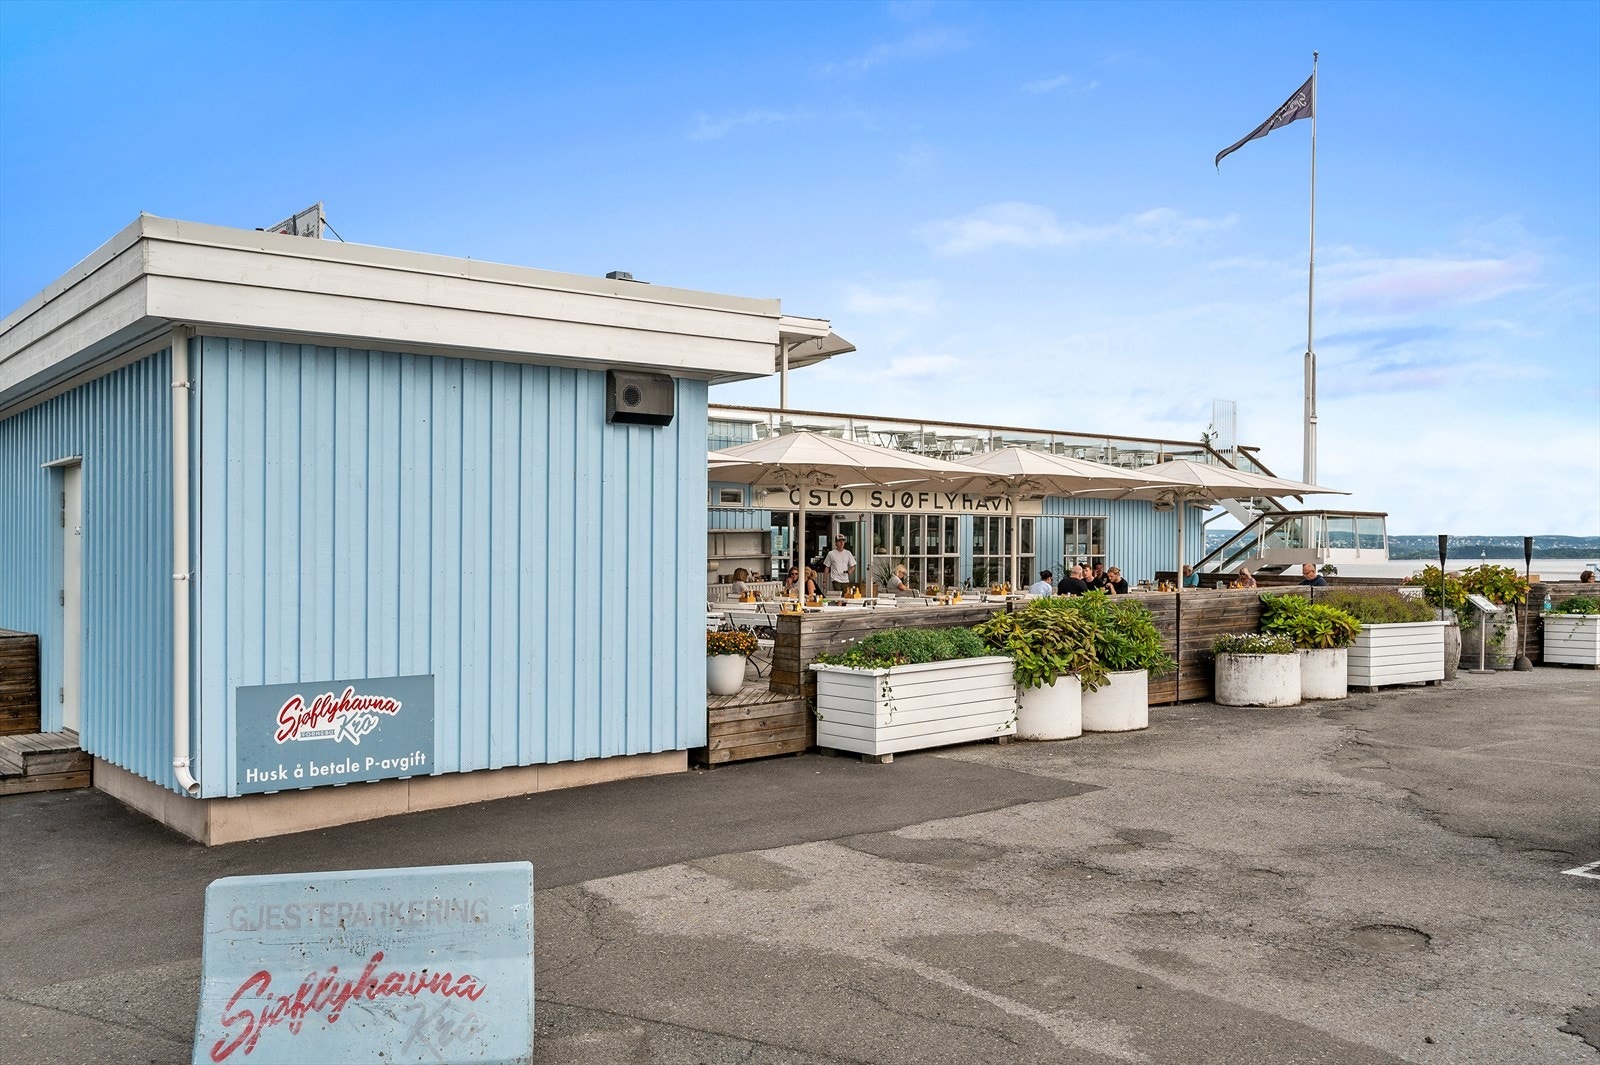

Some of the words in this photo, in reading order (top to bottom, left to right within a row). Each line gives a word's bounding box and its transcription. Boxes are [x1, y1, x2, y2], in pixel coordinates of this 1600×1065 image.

[789, 489, 854, 507] OSLO
[277, 688, 400, 742] Sjøflyhavna
[336, 712, 377, 744] Kro
[246, 764, 288, 783] Husk
[293, 764, 304, 779] å
[309, 757, 360, 777] betale
[365, 750, 426, 771] P-avgift
[229, 898, 489, 932] GJESTEPARKERING
[210, 951, 487, 1063] Sjøflyhavna
[400, 999, 488, 1061] Kro
